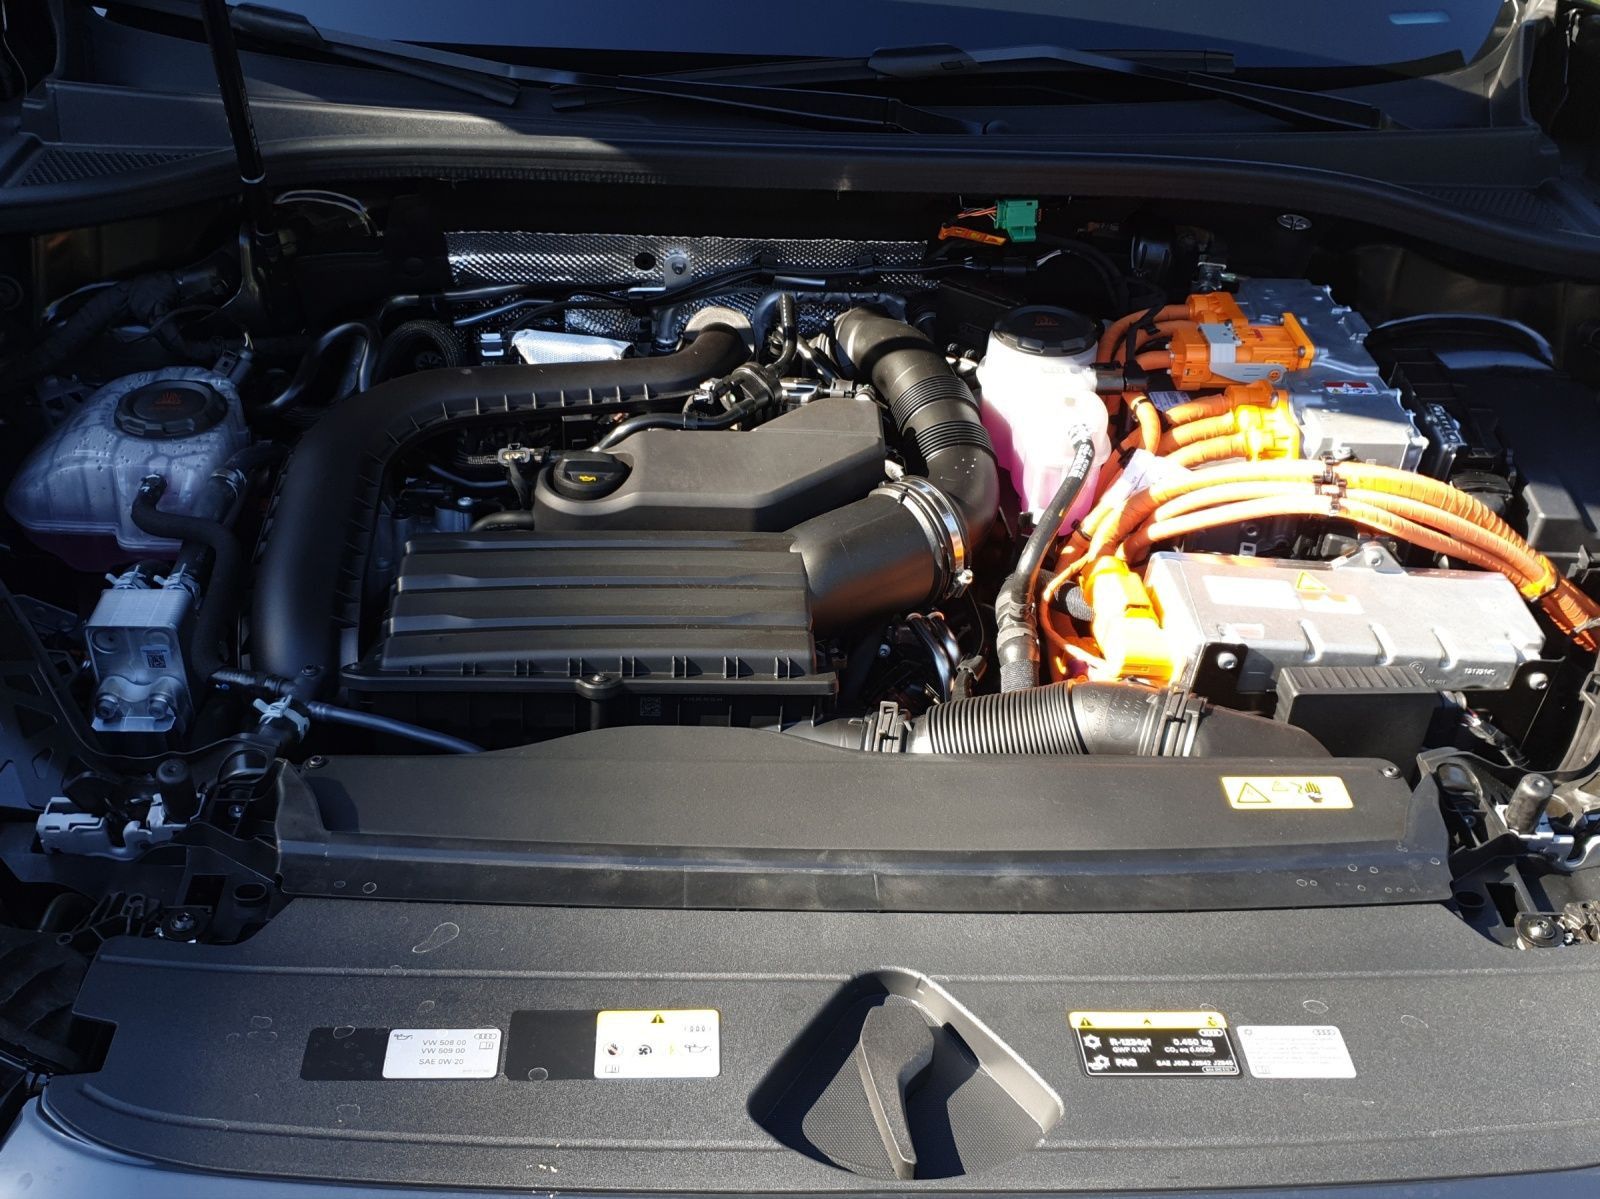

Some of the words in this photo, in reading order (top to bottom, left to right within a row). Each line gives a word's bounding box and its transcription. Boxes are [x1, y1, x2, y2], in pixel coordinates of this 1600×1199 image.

[1200, 1038, 1213, 1047] kg
[1112, 1046, 1131, 1054] GWP
[1114, 1058, 1138, 1068] PAG
[1156, 1059, 1172, 1067] SAE
